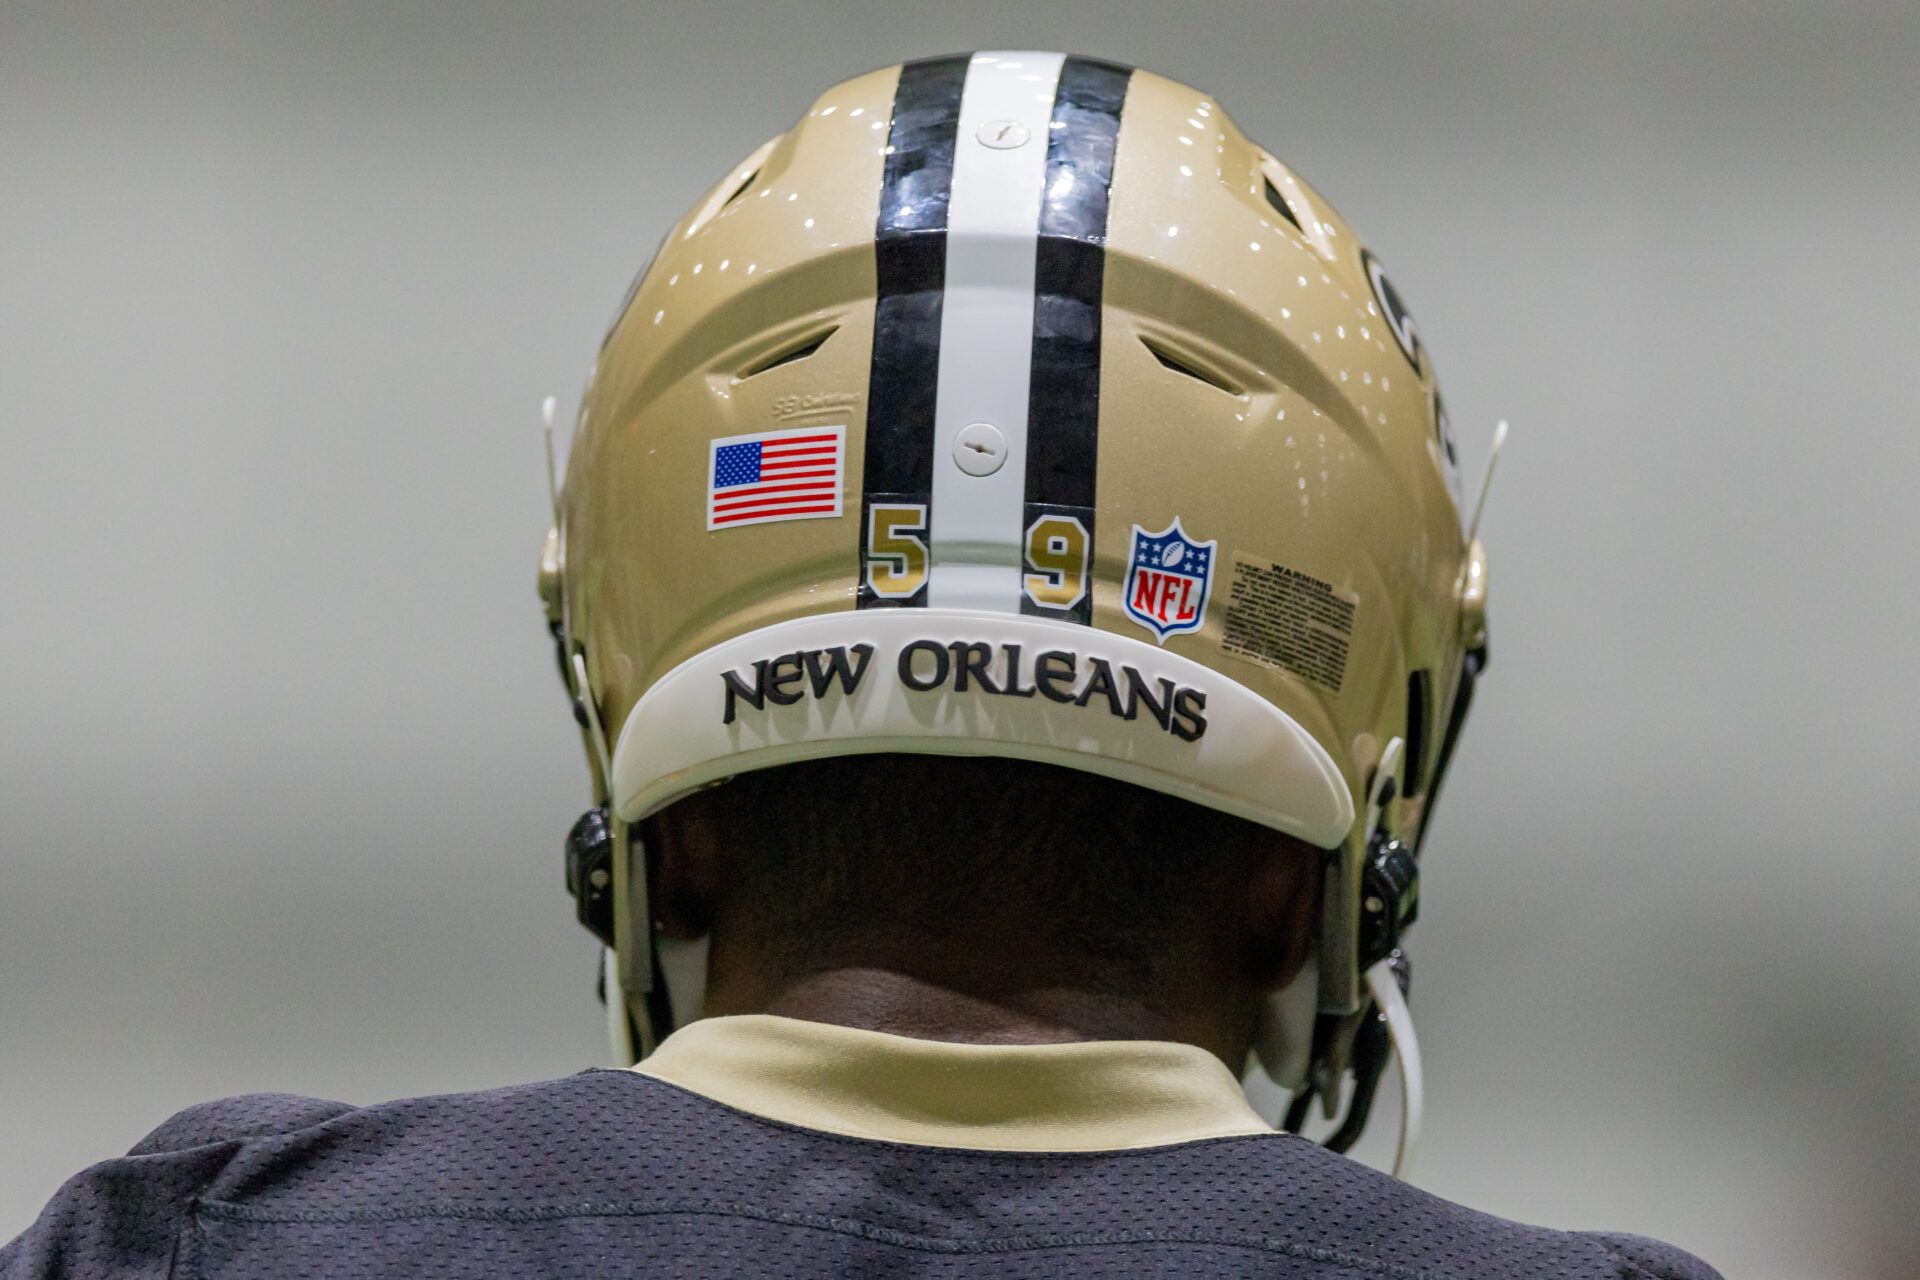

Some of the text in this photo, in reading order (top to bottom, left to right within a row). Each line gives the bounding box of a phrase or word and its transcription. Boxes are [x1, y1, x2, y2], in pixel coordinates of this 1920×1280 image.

[867, 503, 1090, 610] 5 9
[1133, 569, 1196, 623] NFL
[1271, 563, 1333, 593] WARNING
[720, 639, 1208, 743] NEW ORLEANS
